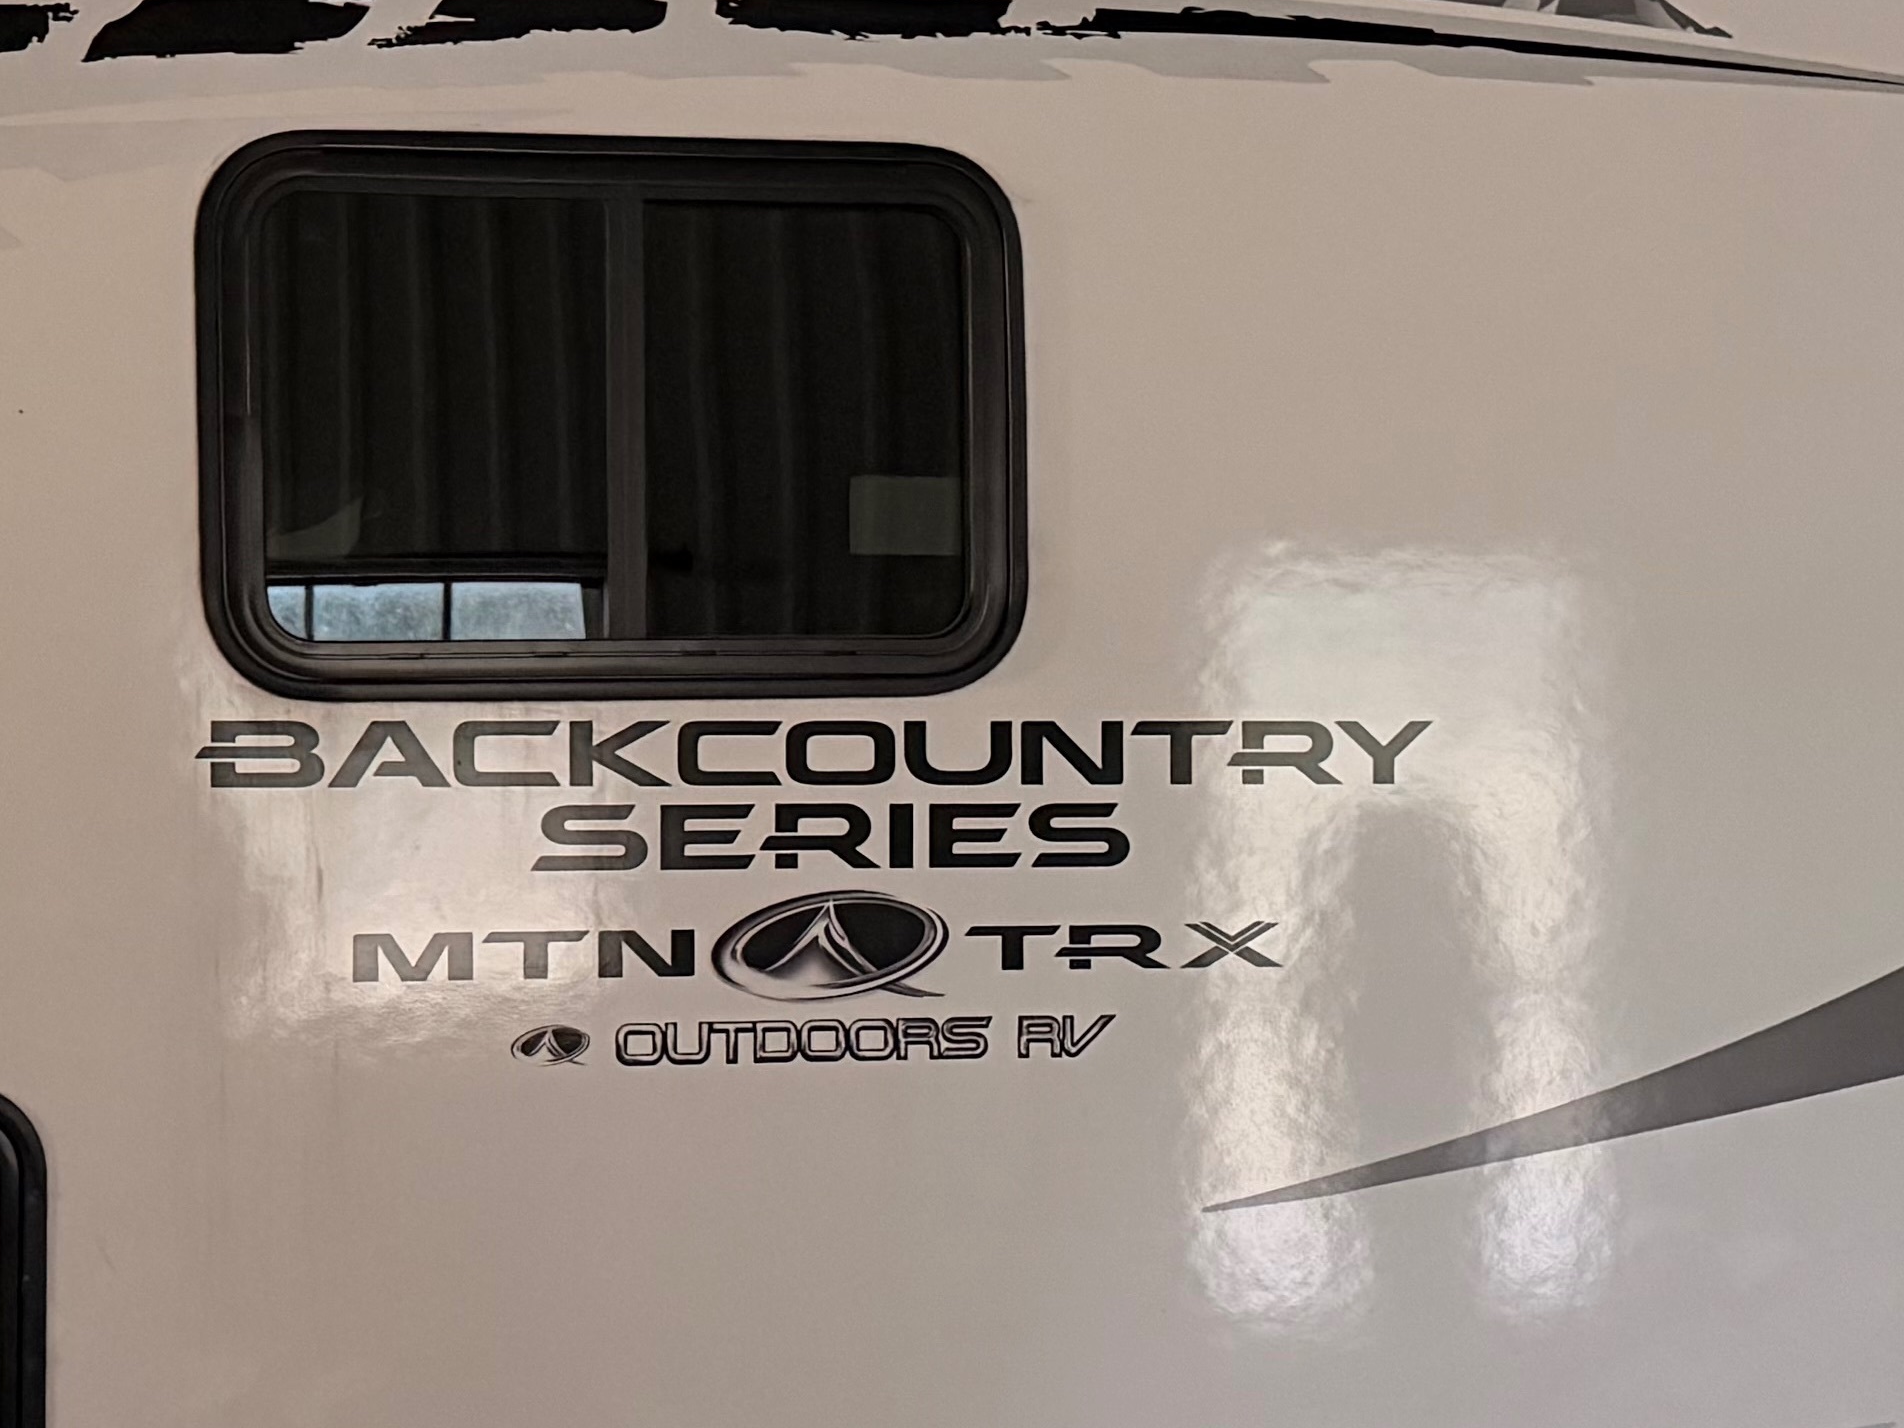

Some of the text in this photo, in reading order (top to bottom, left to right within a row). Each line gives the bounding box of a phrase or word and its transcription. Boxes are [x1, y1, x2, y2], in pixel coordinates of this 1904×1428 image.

[194, 719, 1434, 788] BACKCOUNTRY
[530, 802, 1131, 871] SERIES
[352, 920, 1284, 983] MTN TRX
[615, 1014, 1116, 1066] OUTDOORS RV
